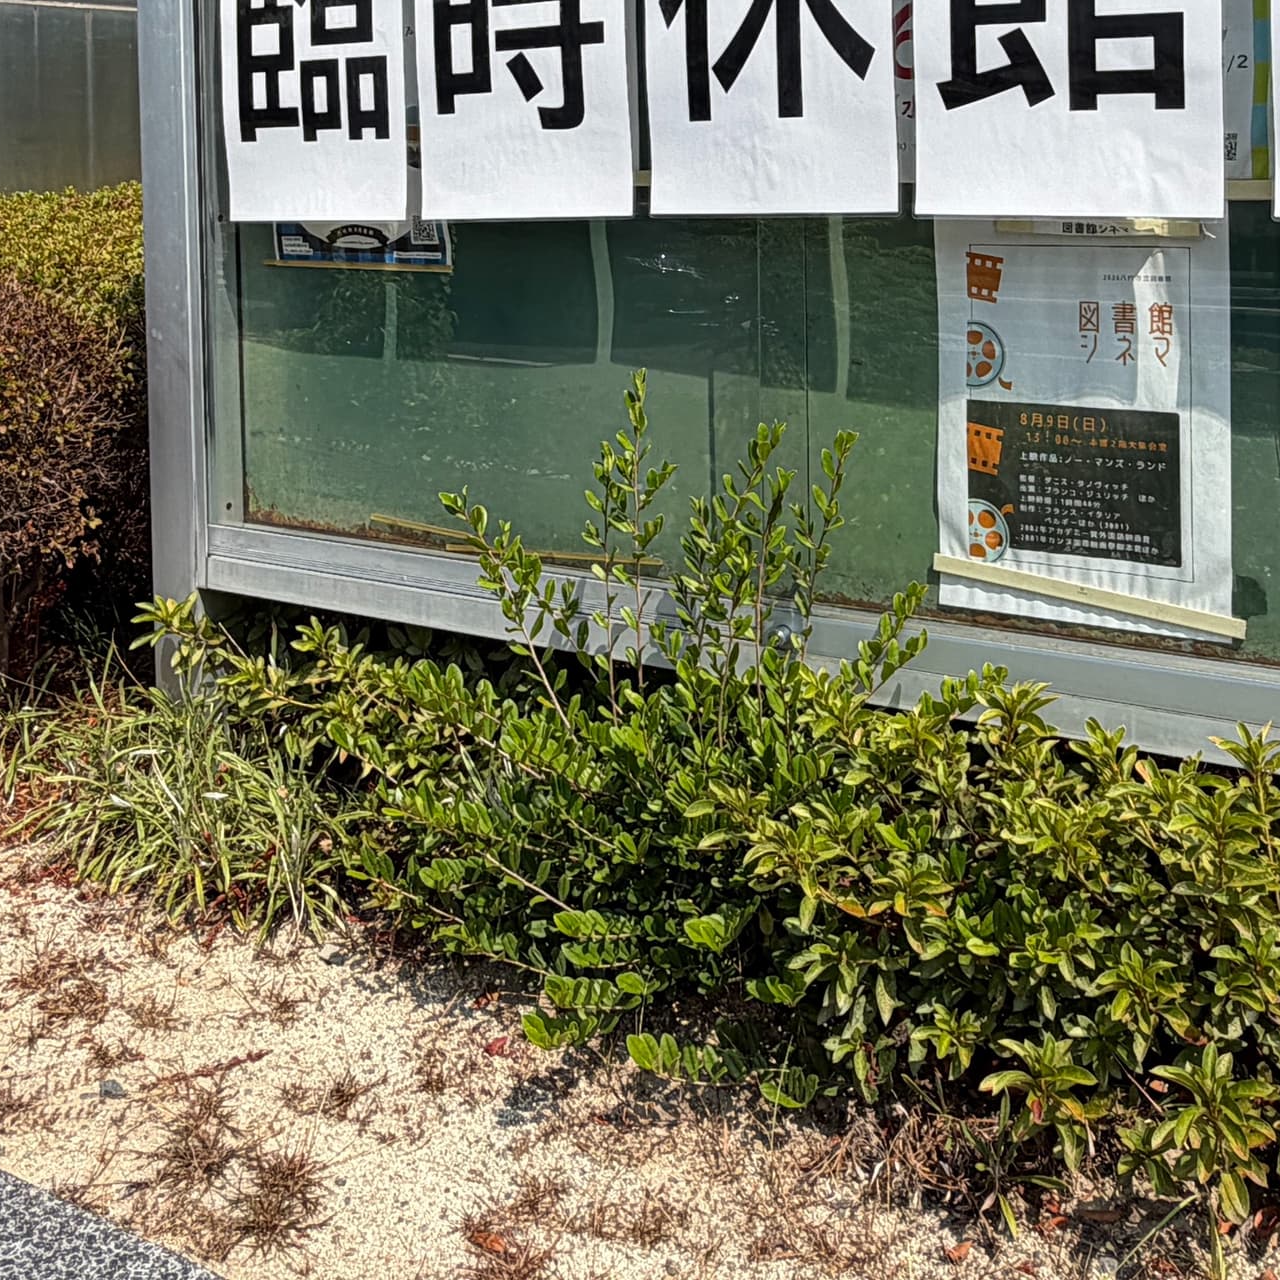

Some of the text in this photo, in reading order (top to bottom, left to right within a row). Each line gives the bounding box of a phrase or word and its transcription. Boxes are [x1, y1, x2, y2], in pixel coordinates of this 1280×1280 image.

[1079, 300, 1174, 336] 図書館
[1080, 334, 1171, 367] シネマ
